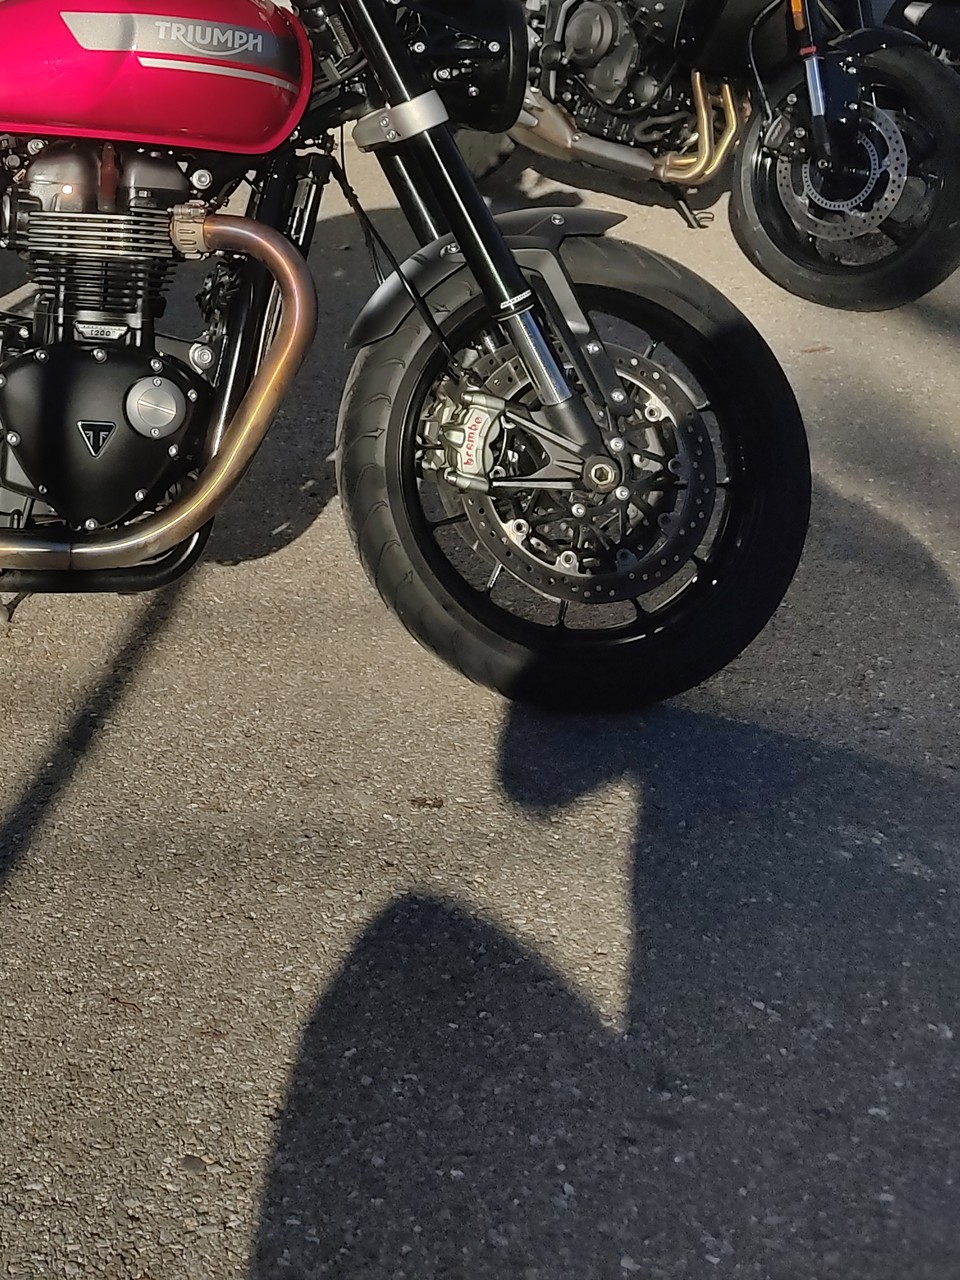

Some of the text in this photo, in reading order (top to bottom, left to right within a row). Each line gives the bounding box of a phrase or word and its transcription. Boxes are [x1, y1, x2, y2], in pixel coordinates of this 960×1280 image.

[154, 21, 263, 55] TRIUMPH
[90, 329, 111, 337] 1200
[463, 416, 482, 466] brembo
